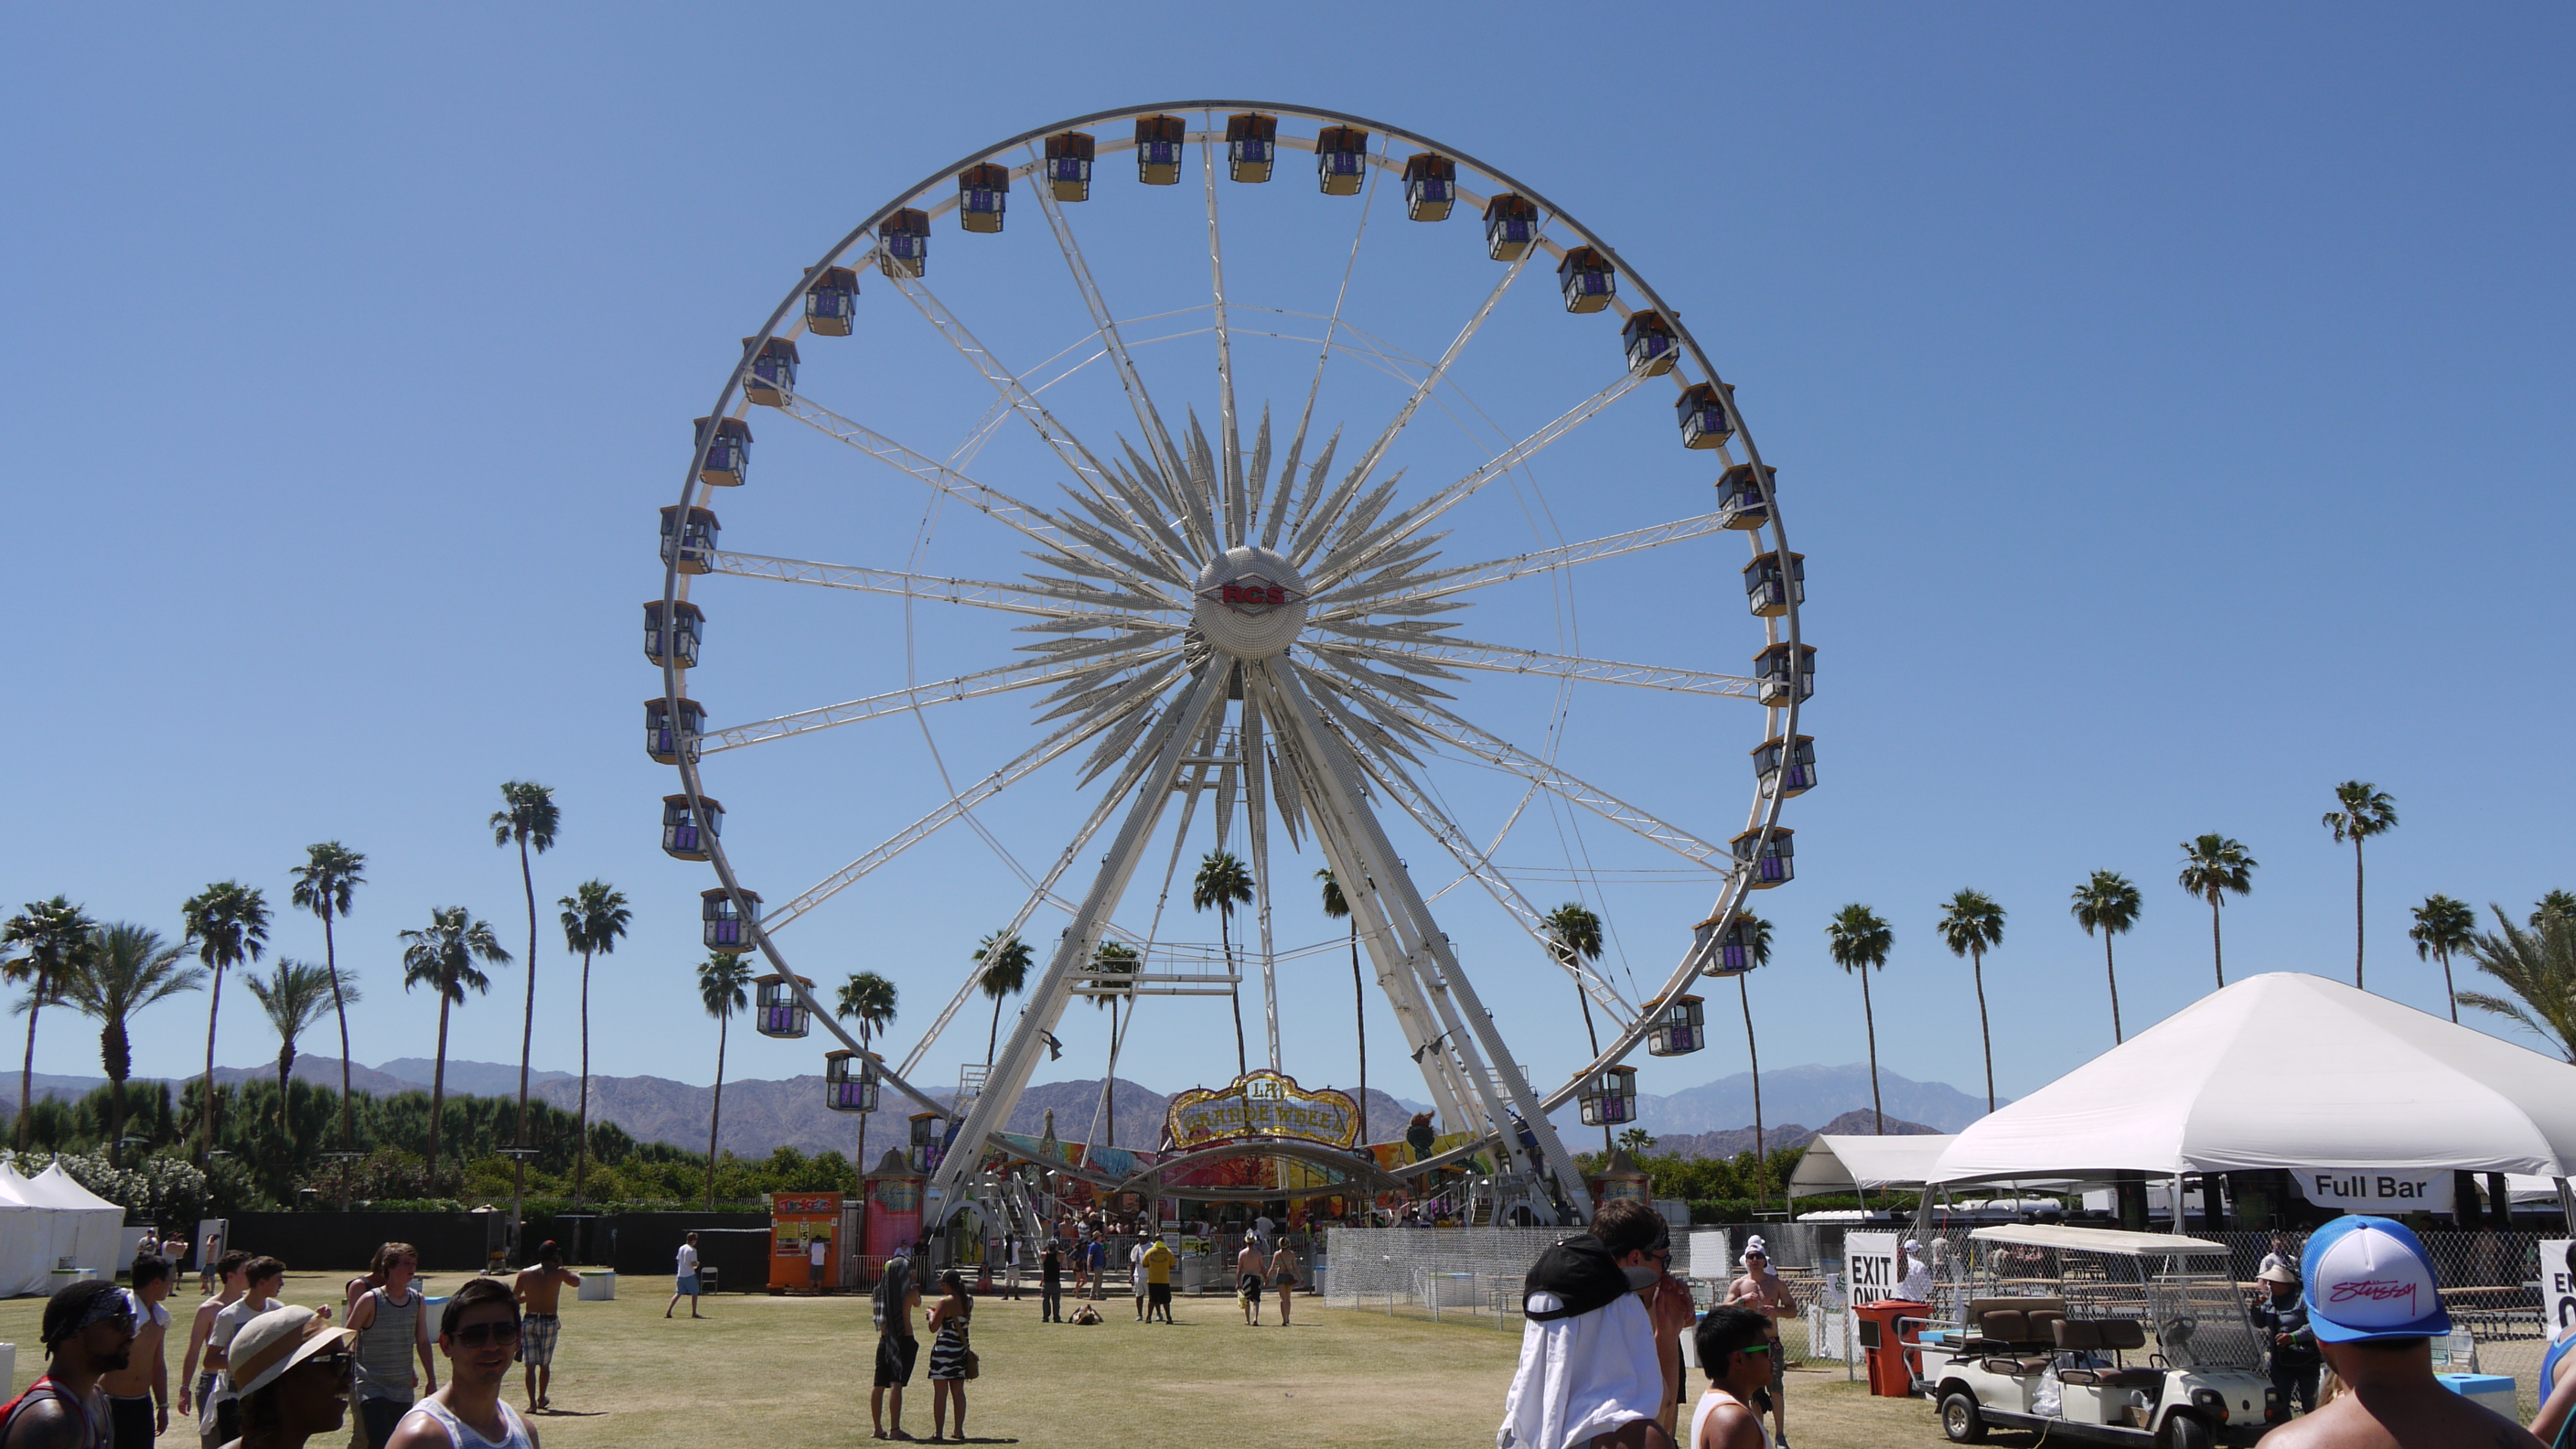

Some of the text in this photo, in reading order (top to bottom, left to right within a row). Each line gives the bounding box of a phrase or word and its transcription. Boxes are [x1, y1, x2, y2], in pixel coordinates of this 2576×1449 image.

[1223, 585, 1285, 604] RCS
[1253, 1082, 1278, 1098] LA
[1184, 1106, 1271, 1132] GRANDE
[2315, 1175, 2427, 1198] Full Bar
[778, 1197, 832, 1212] TICKETS
[1852, 1255, 1892, 1286] EXIT
